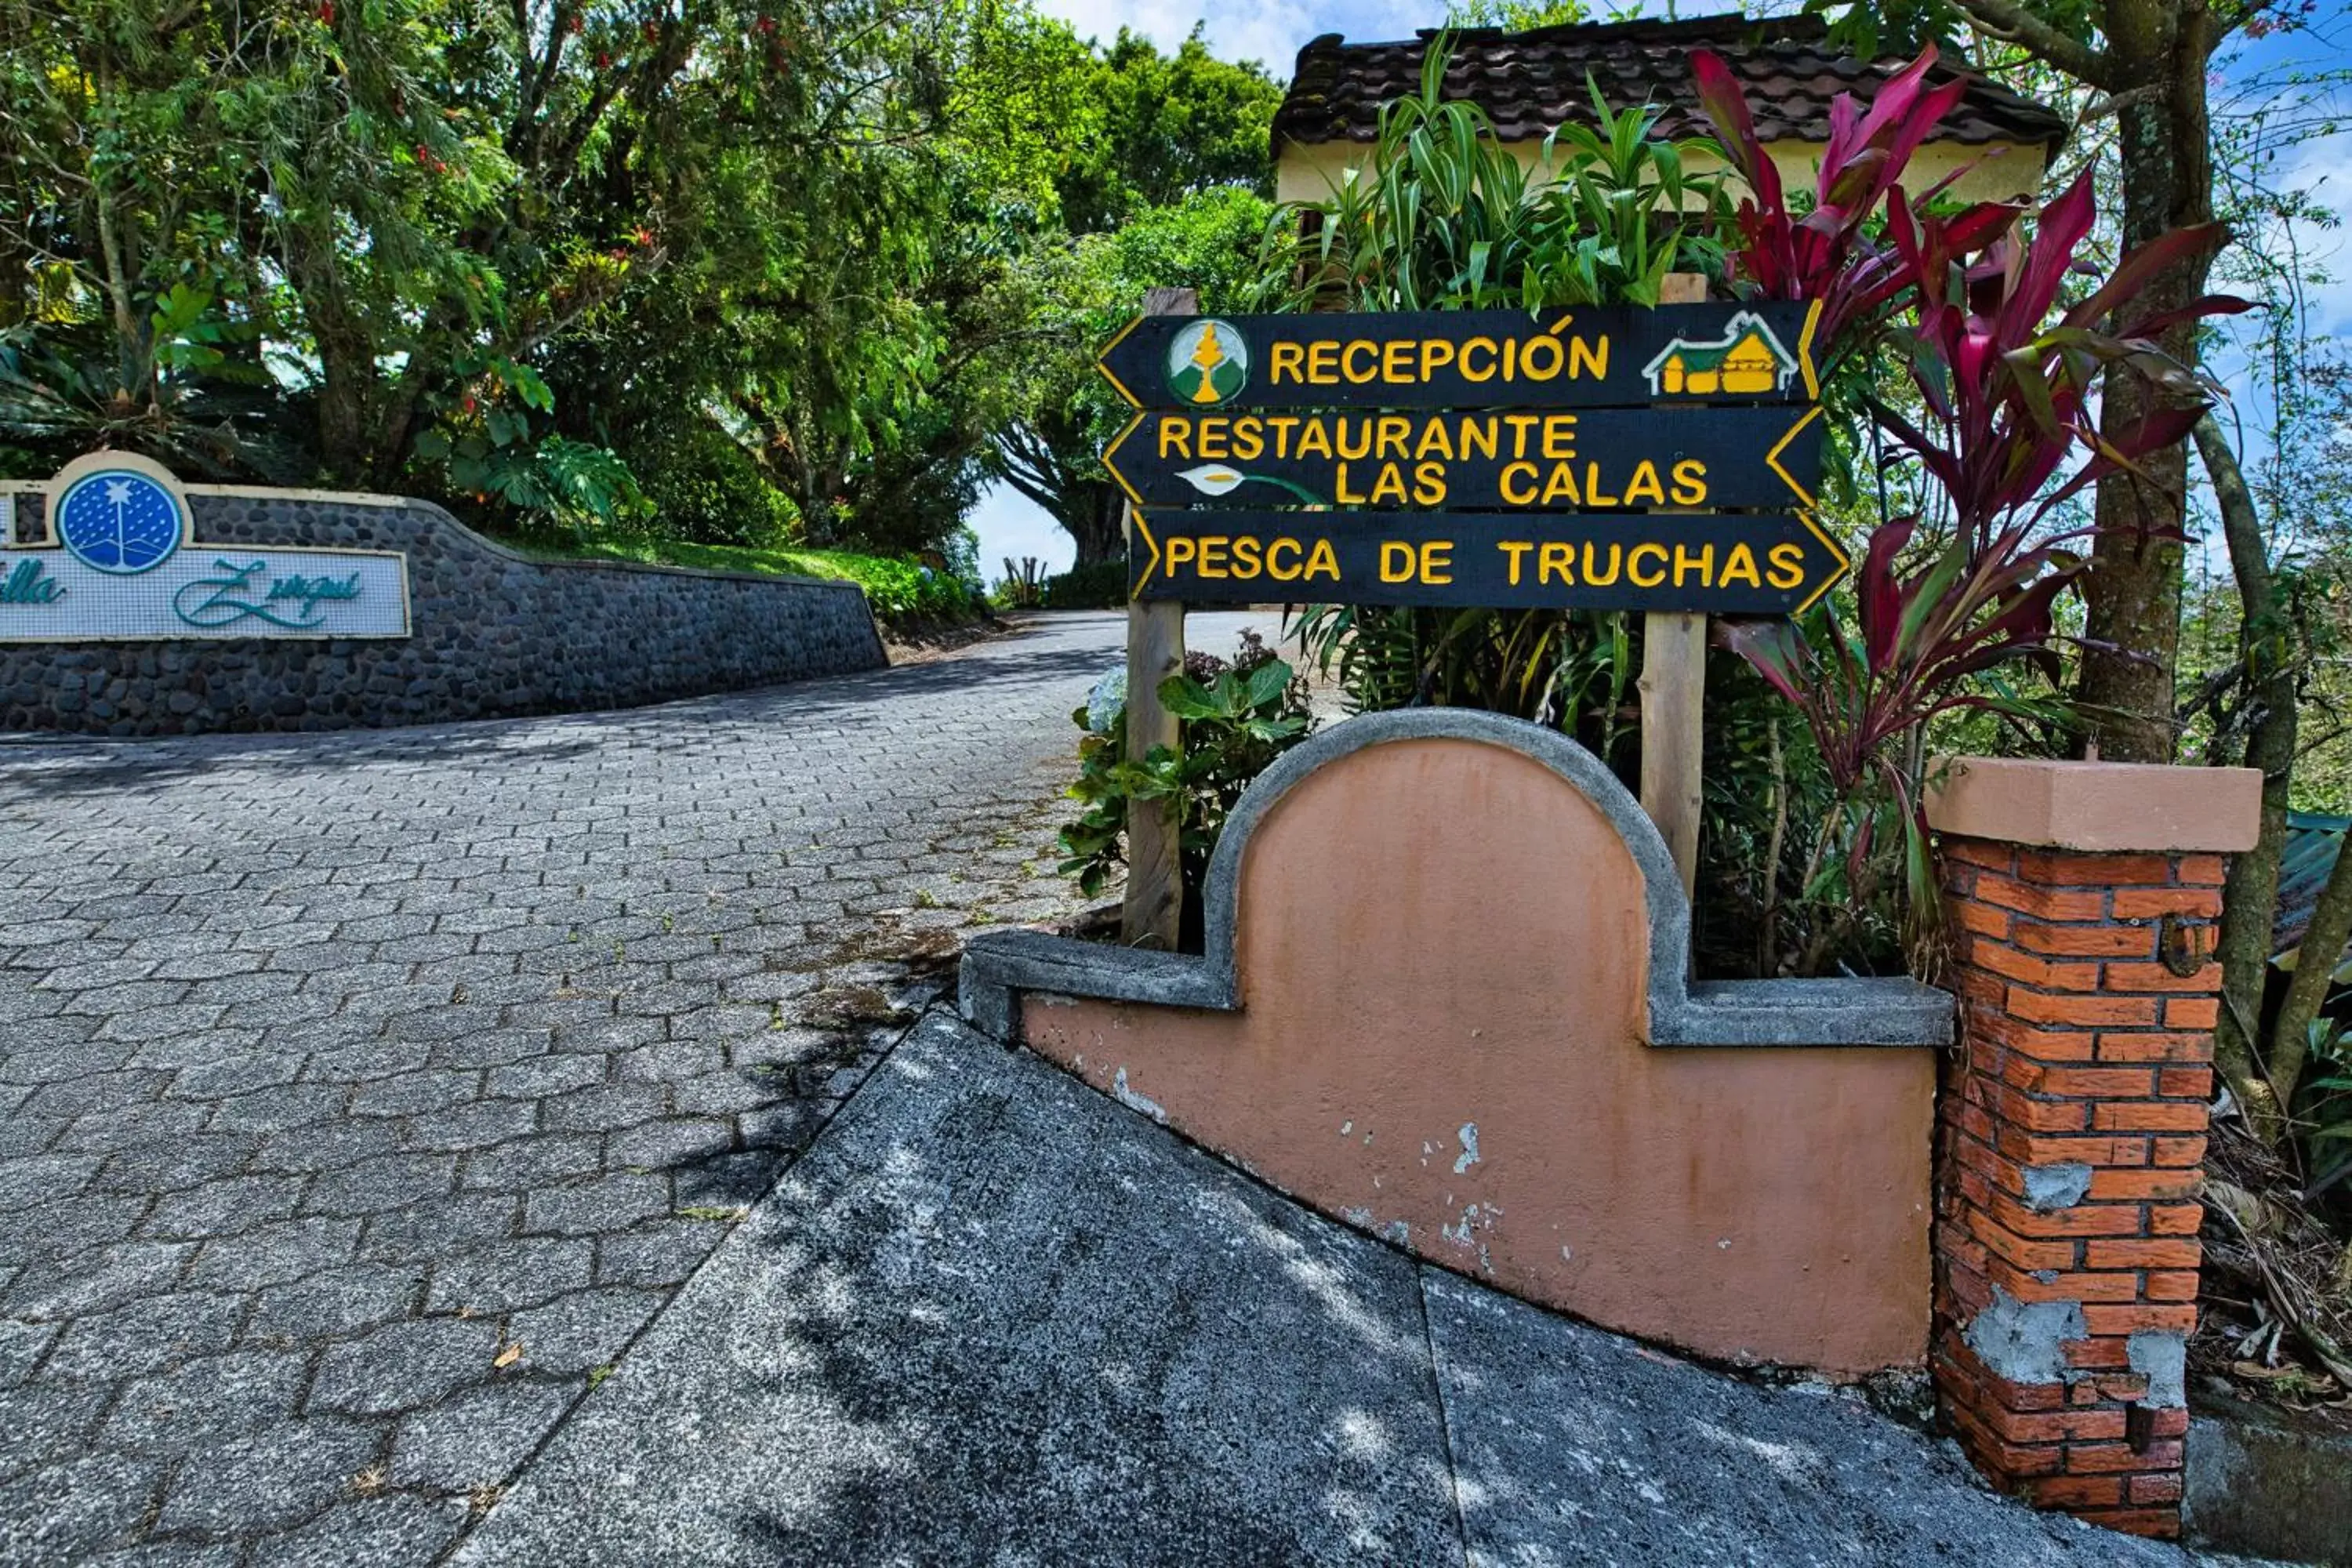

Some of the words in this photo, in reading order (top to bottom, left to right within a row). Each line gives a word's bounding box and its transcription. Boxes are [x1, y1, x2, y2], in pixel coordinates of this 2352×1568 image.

[1271, 314, 1609, 384] RECEPCIÓN
[1159, 415, 1578, 461] RESTAURANTE
[1336, 461, 1446, 506] LAS
[1500, 459, 1707, 507] CALAS
[1165, 536, 1341, 581] PESCA
[1379, 541, 1454, 584] DE
[1497, 541, 1805, 590] TRUCHAS
